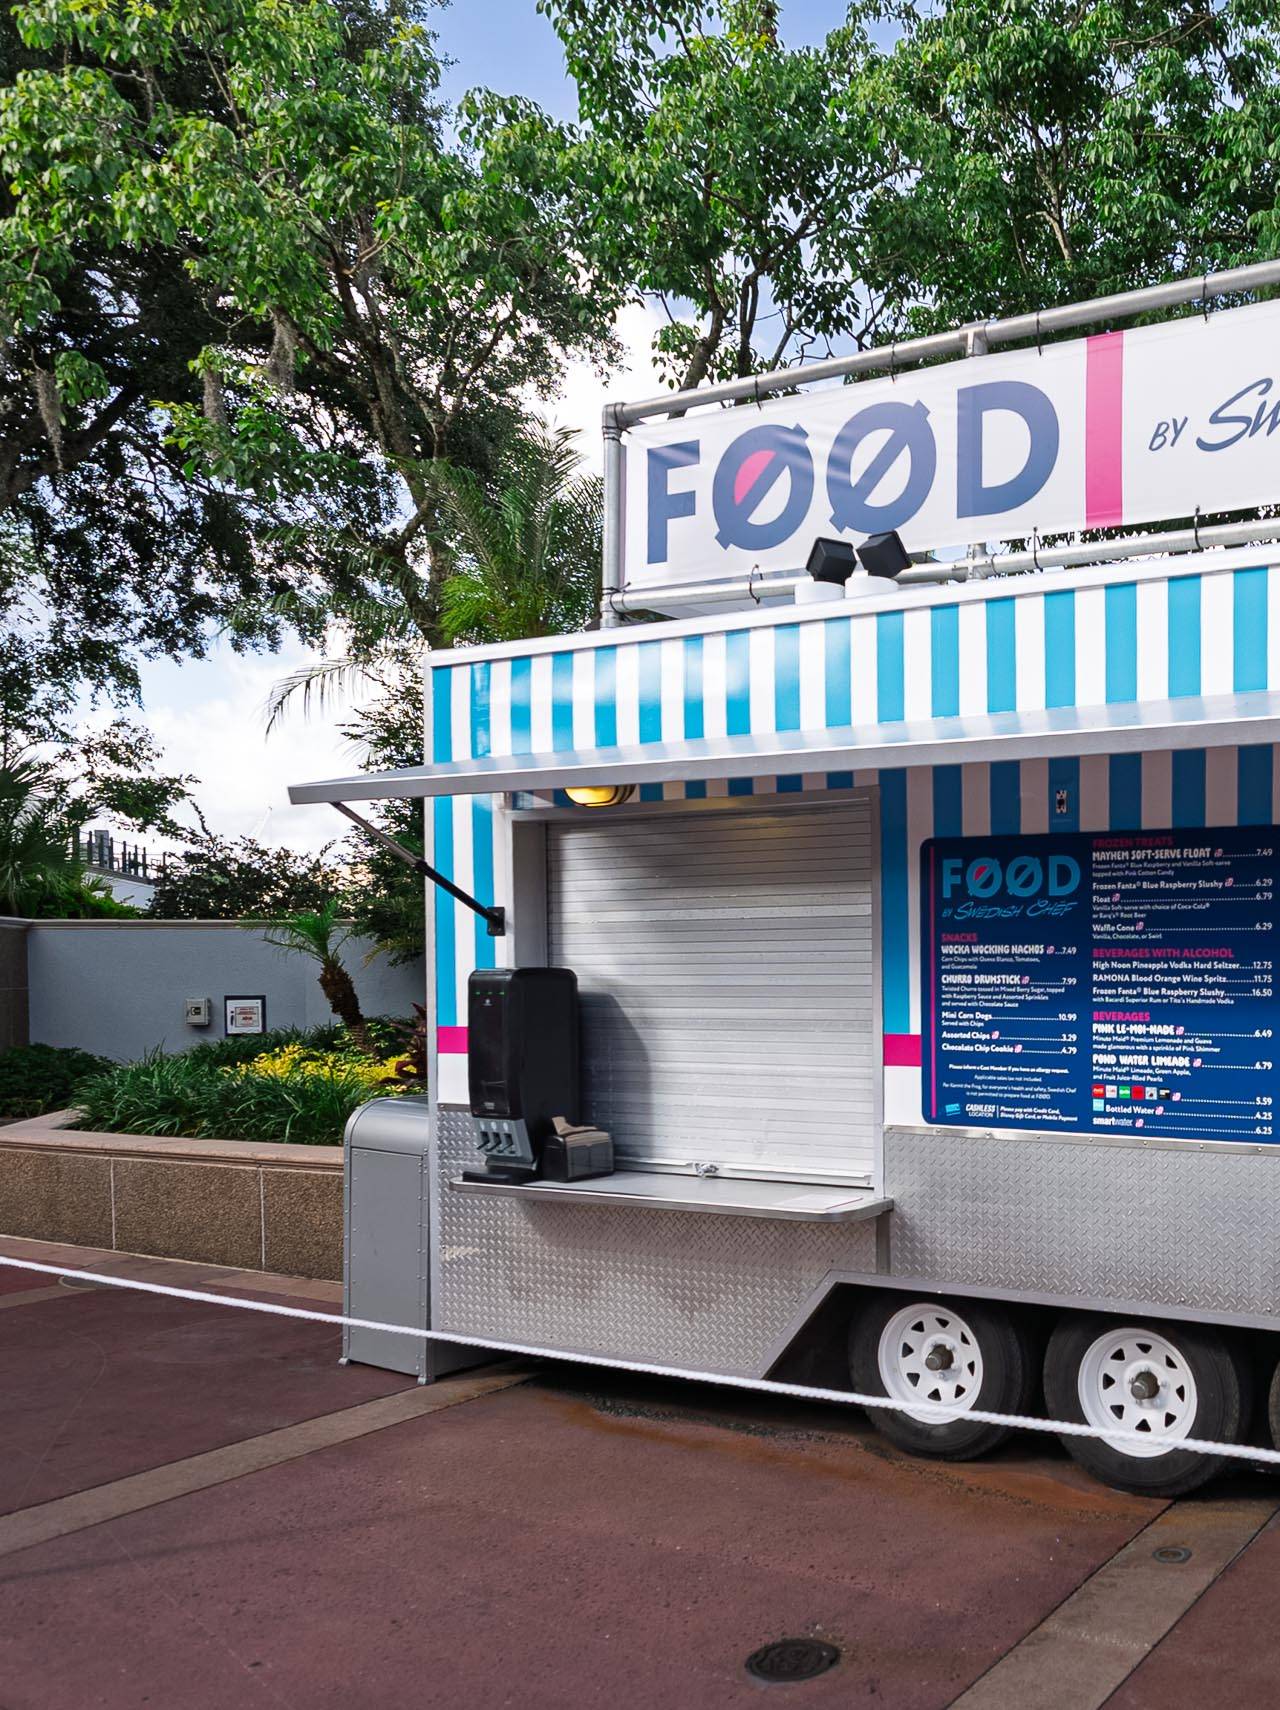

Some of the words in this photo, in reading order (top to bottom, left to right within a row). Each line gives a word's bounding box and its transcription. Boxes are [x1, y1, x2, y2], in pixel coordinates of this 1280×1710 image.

[1149, 416, 1188, 452] BY
[646, 380, 1060, 564] FØØD
[1093, 838, 1132, 848] FROZEN
[1136, 837, 1173, 847] TREATS
[1093, 851, 1129, 861] MAYHEM
[1131, 849, 1182, 860] SOFT-SERVE
[1183, 848, 1212, 859] FLOAT
[1257, 848, 1272, 857] 7.49
[942, 855, 1081, 898] FØØD
[1093, 882, 1117, 890] Frozen
[1143, 881, 1159, 889] Blue
[1160, 880, 1197, 890] Raspberry
[1198, 880, 1223, 889] Slushy
[1256, 879, 1272, 887] 6.29
[1093, 895, 1111, 903] Float
[1256, 892, 1272, 901] 6.79
[1093, 923, 1116, 932] Waffle
[1117, 923, 1136, 931] Cone
[1256, 922, 1272, 931] 6.29
[941, 932, 978, 942] SNACKS
[941, 945, 969, 954] WOCKA
[972, 945, 1009, 954] WOCKING
[1012, 945, 1044, 954] NACHOS
[1062, 947, 1077, 955] 7.49
[1093, 948, 1151, 958] BEVERAGES
[1152, 948, 1181, 958] WITH
[1182, 948, 1234, 958] ALCOHOL
[1093, 961, 1110, 970] High
[1111, 961, 1131, 969] Noon
[1133, 961, 1169, 971] Pineapple
[1170, 961, 1192, 969] Vodka
[1194, 961, 1213, 969] Hard
[1214, 961, 1240, 969] Seltzer
[1253, 961, 1273, 969] 12.75
[941, 975, 972, 984] CHURRO
[974, 975, 1020, 984] DRUMSTICK
[1062, 977, 1077, 985] 7.99
[1093, 973, 1130, 982] RAMONA
[1132, 974, 1153, 982] Blood
[1154, 973, 1181, 984] Orange
[1182, 974, 1202, 983] Wine
[1204, 974, 1227, 984] Spritz
[1254, 975, 1273, 983] 11.75
[1093, 987, 1117, 995] Frozen
[1144, 987, 1160, 996] Blue
[1161, 987, 1199, 997] Raspberry
[1200, 988, 1225, 998] Slushy
[1252, 988, 1273, 997] 16.50
[976, 1012, 992, 1022] Dogs
[1059, 1013, 1077, 1022] 10.99
[1093, 1011, 1151, 1021] BEVERAGES
[1093, 1023, 1115, 1034] PINK
[1116, 1024, 1175, 1035] LE-MOI-NADE
[1255, 1029, 1273, 1038] 6.49
[942, 1031, 970, 1039] Assorted
[972, 1031, 990, 1041] Chips
[1061, 1034, 1077, 1042] 3.29
[942, 1043, 973, 1051] Chocolate
[975, 1044, 990, 1053] Chip
[991, 1044, 1014, 1053] Cookie
[1062, 1047, 1077, 1055] 4.79
[1093, 1054, 1117, 1065] POND
[1119, 1054, 1149, 1066] WATER
[1151, 1055, 1190, 1067] LIMEADE
[1255, 1062, 1273, 1070] 6.79
[1256, 1097, 1273, 1106] 5.59
[966, 1104, 996, 1113] CASHLESS
[1106, 1105, 1132, 1114] Bottled
[1133, 1105, 1155, 1115] Water
[1256, 1112, 1273, 1121] 4.25
[1256, 1126, 1273, 1135] 6.25
